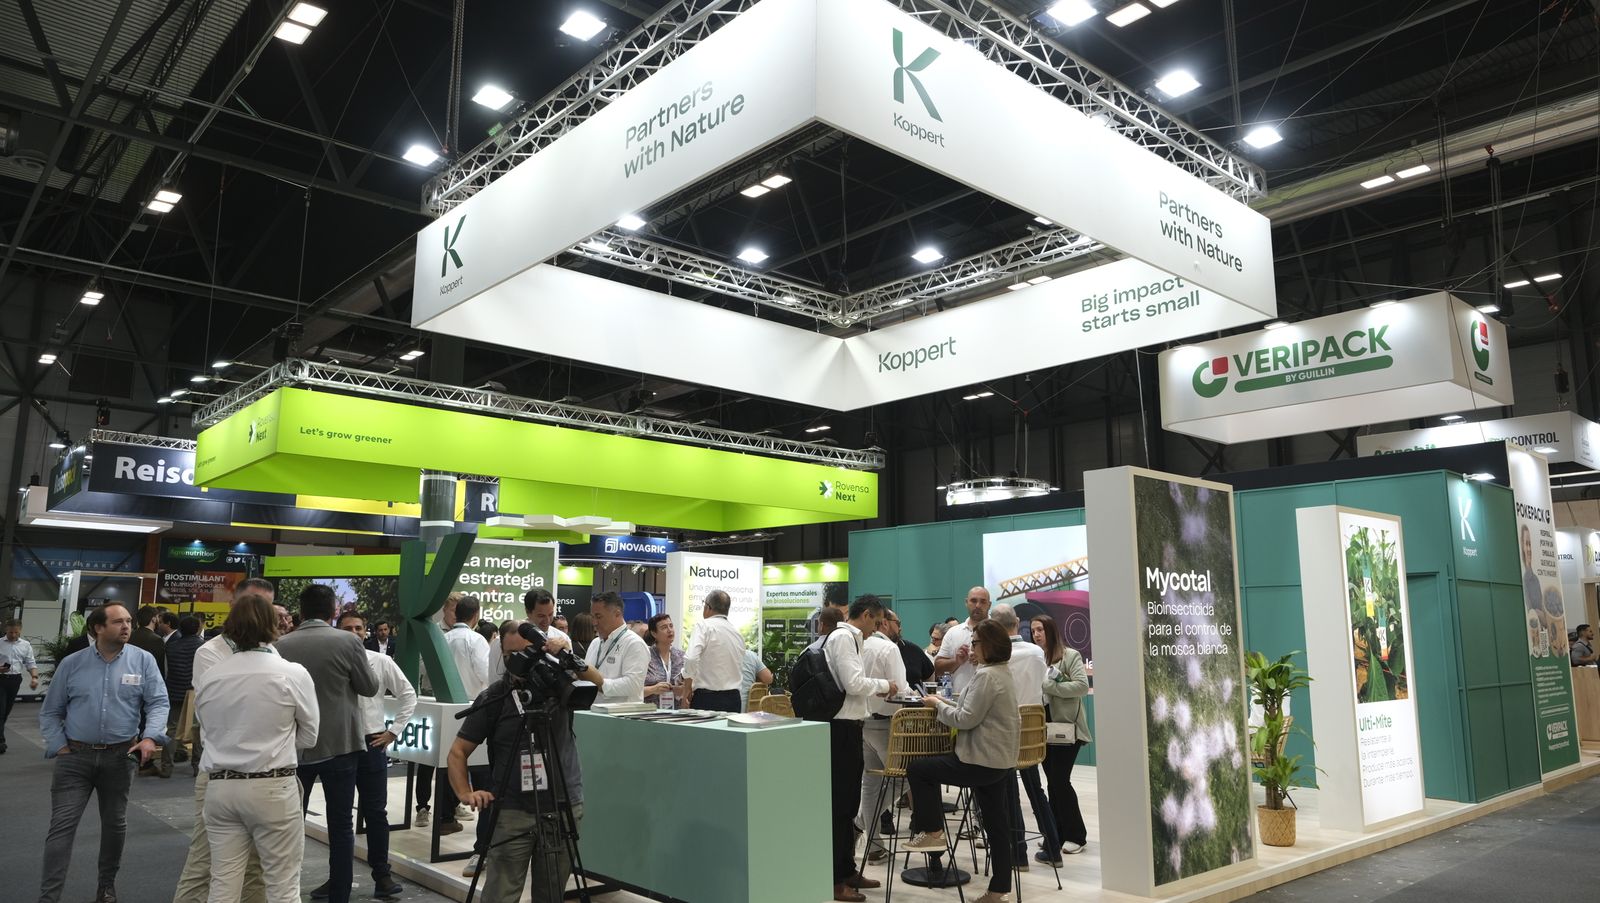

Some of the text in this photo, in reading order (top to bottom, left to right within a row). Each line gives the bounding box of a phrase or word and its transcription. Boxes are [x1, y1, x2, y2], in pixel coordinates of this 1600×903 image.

[625, 80, 714, 150] Partners
[624, 93, 745, 179] with Nature
[893, 112, 945, 148] Koppert
[1159, 189, 1223, 239] Partners
[1159, 219, 1243, 272] with Nature
[439, 275, 464, 296] Koppert
[1081, 274, 1185, 313] Big impact
[1081, 289, 1200, 334] starts small
[878, 336, 957, 374] Koppert
[1233, 324, 1392, 377] VERIPACK
[1285, 367, 1335, 383] BY GUILLIN
[326, 431, 353, 440] grow
[354, 432, 393, 444] greener
[835, 481, 870, 493] Rovensa
[835, 491, 856, 502] Next
[619, 542, 667, 553] NOVAGRIC
[484, 555, 532, 572] mejor
[164, 573, 226, 583] BIOSTIMULANT
[459, 572, 544, 590] estrategia
[689, 565, 739, 581] Natupol
[1146, 566, 1211, 596] Mycotal
[766, 589, 817, 599] Expertos mundiales
[479, 605, 514, 622] lgón
[1147, 601, 1214, 616] Bioinsecticida
[1149, 622, 1232, 638] para el control de
[1149, 641, 1228, 656] la mosca blanca
